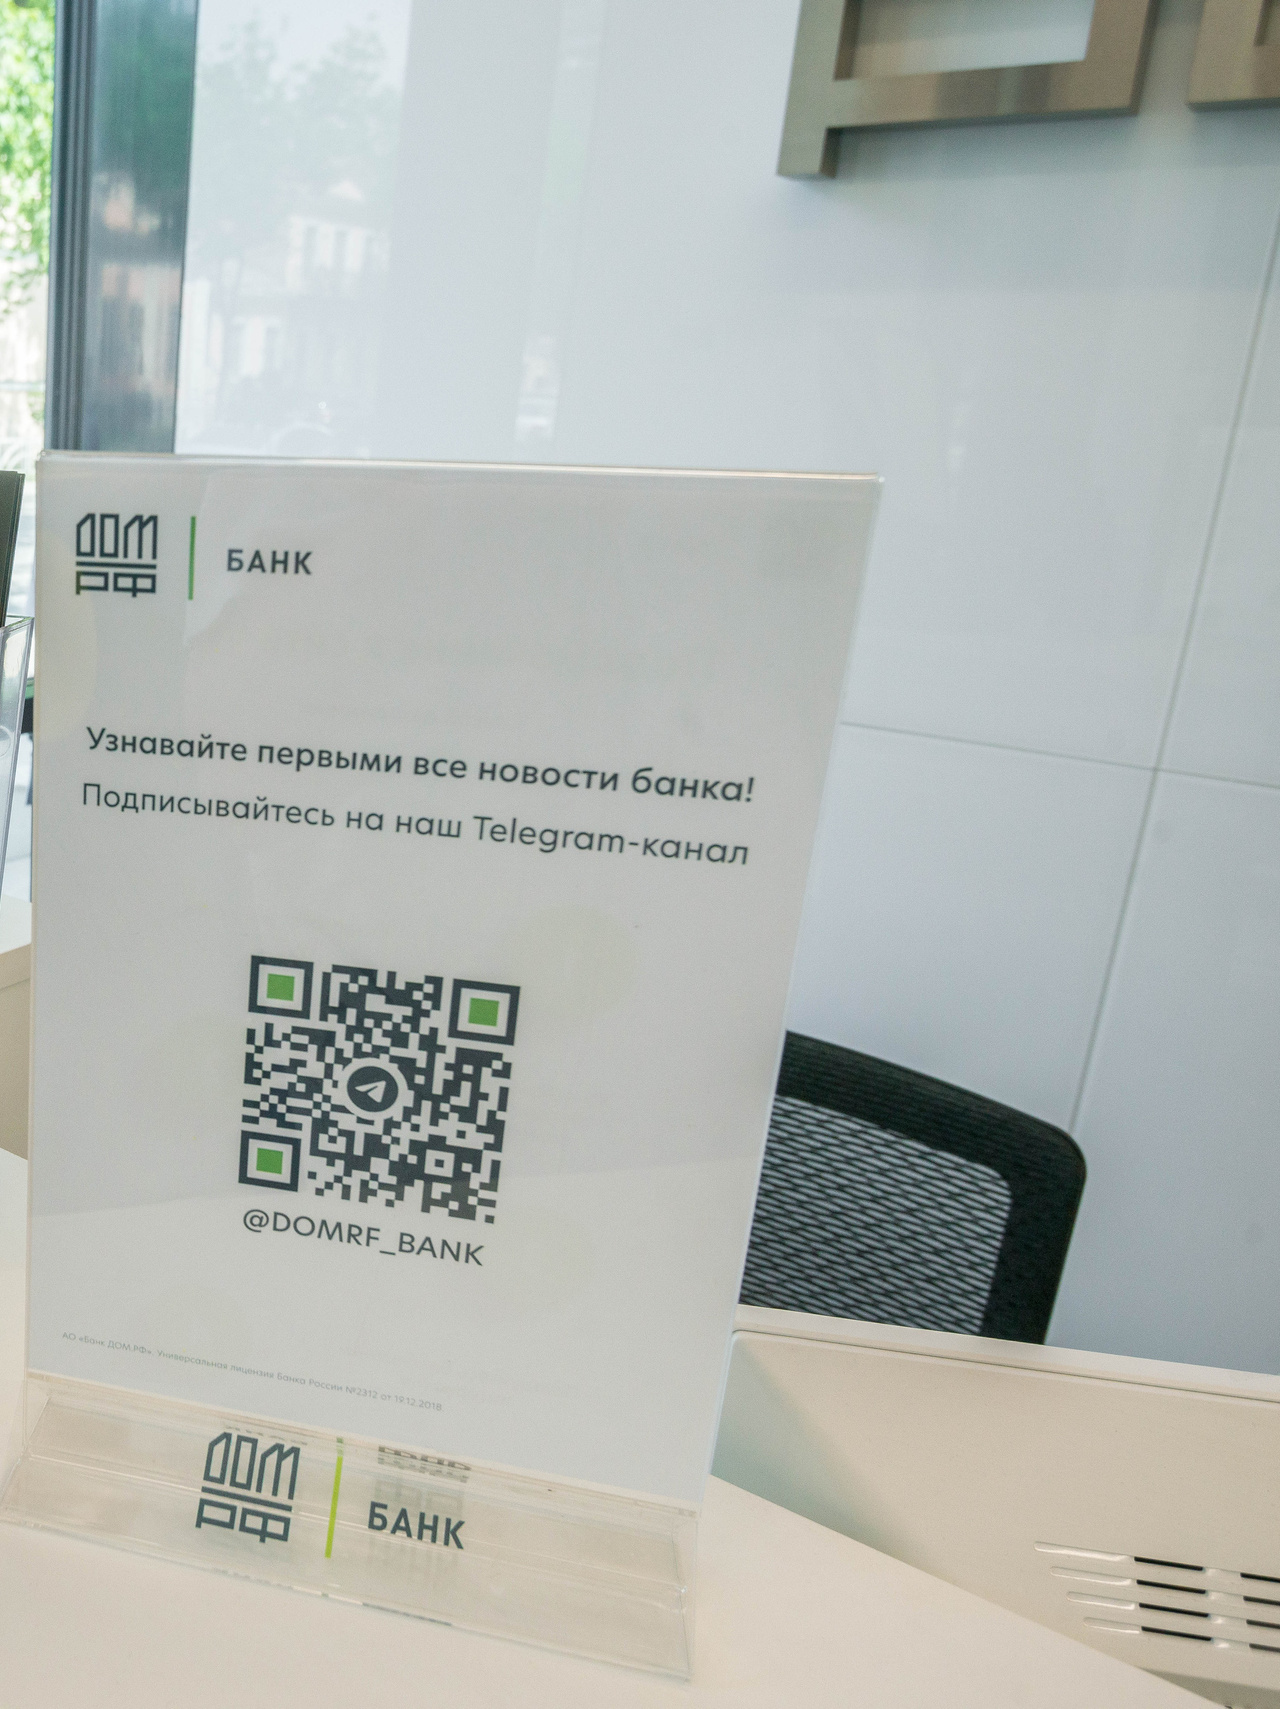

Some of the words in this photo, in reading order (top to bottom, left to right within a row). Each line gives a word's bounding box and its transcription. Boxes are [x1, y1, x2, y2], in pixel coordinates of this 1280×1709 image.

[76, 513, 158, 560] ДОМ
[227, 549, 312, 575] БАНК
[76, 571, 156, 597] РФ
[86, 726, 247, 761] Узнавайте
[258, 743, 402, 774] первыми
[413, 757, 467, 778] все
[478, 761, 619, 792] новости
[631, 767, 755, 802] банка!
[82, 783, 335, 827] Подписывайтесь
[346, 810, 384, 831] на
[396, 814, 462, 839] наш
[473, 816, 749, 866] Telegram-канал
[243, 1209, 485, 1266] @DOMRF_BANK
[62, 1332, 76, 1341] АО
[78, 1335, 105, 1346] «Банк
[157, 1349, 228, 1369] Универсальная
[230, 1364, 275, 1379] лицензия
[277, 1372, 306, 1385] Банка
[309, 1378, 343, 1392] России
[345, 1385, 378, 1399] №2312
[381, 1393, 392, 1401] от
[202, 1431, 301, 1500] ДОМ
[195, 1498, 291, 1543] РФ
[367, 1501, 466, 1549] БАНК
